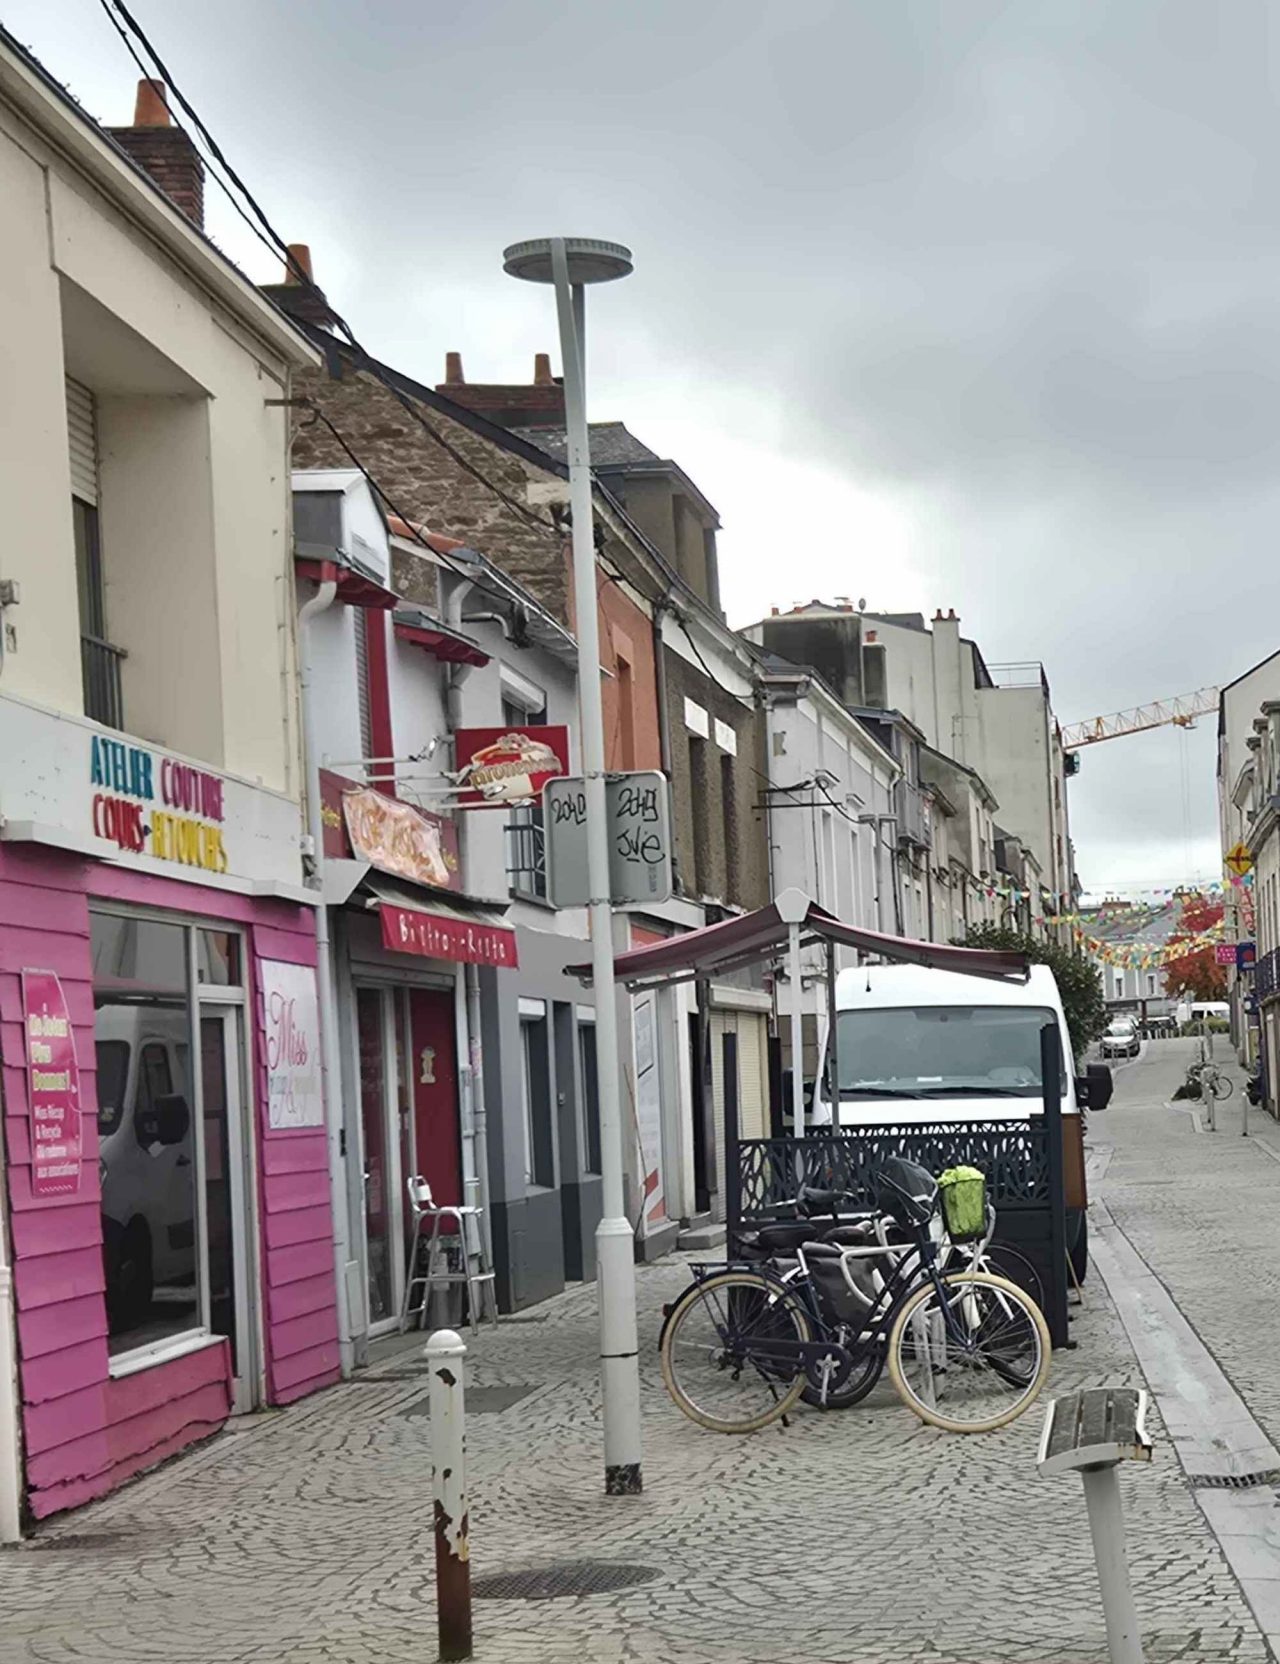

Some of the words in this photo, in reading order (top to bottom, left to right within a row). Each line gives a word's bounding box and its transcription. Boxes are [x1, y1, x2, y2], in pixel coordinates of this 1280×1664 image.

[91, 735, 154, 800] ATELIER
[161, 757, 225, 823] COUTURE
[93, 793, 145, 854] COURS
[152, 810, 228, 874] RETOUCHES
[267, 991, 308, 1071] Miss
